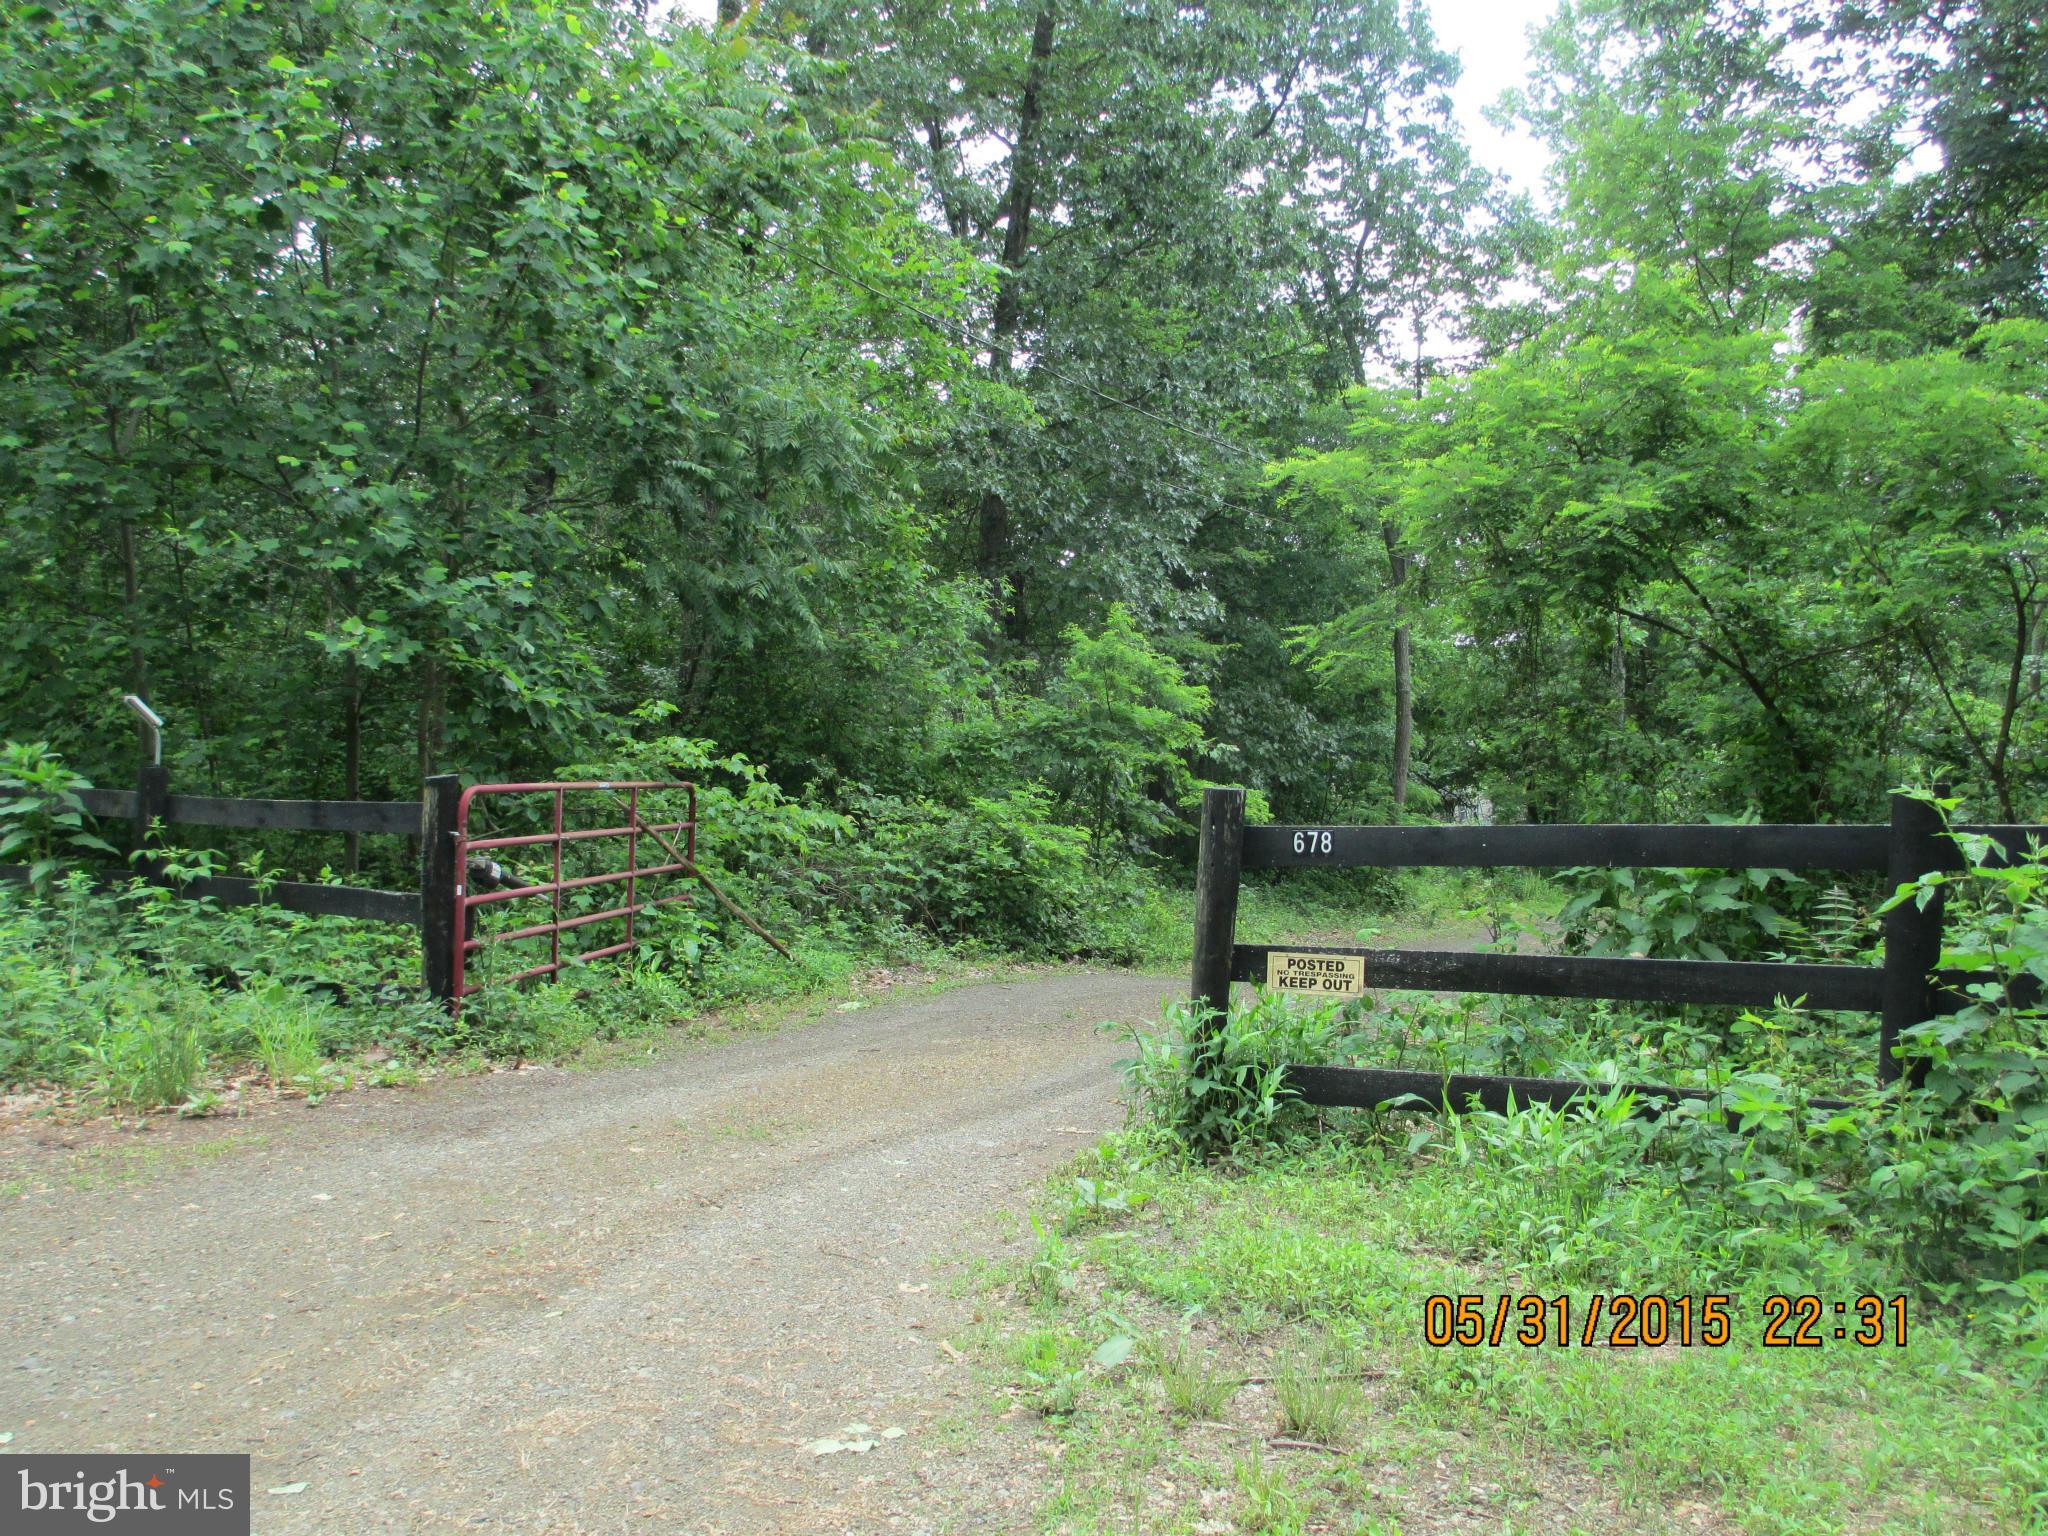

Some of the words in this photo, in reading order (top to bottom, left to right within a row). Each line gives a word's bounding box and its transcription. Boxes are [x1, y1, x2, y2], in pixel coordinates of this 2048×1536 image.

[1293, 831, 1332, 853] 678
[1287, 958, 1345, 972] POSTED
[1293, 970, 1355, 980] TRESPASSING
[1279, 976, 1317, 989] KEEP
[1322, 979, 1352, 991] OUT
